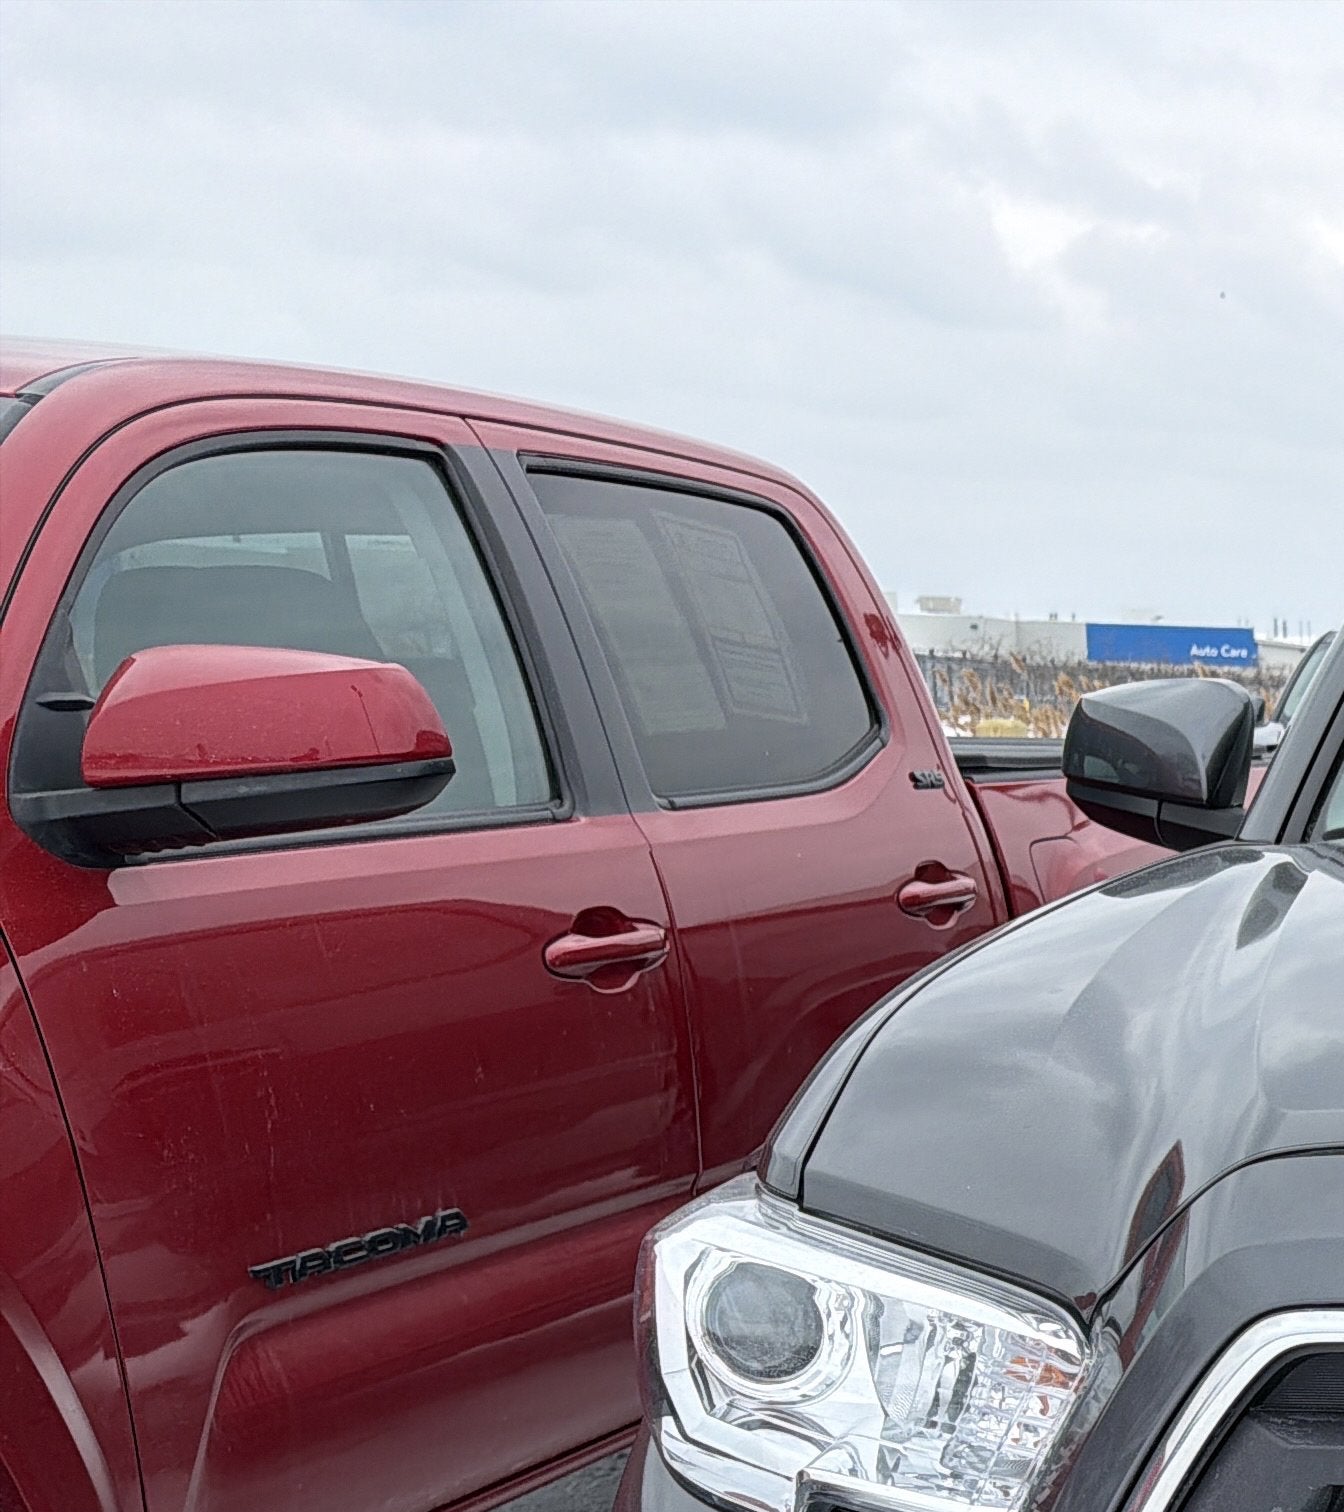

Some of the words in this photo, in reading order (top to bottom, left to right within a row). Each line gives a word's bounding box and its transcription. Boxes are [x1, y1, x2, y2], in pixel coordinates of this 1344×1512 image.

[1190, 643, 1219, 658] Auto
[1220, 643, 1248, 659] Care
[247, 1206, 470, 1291] TACOMA
